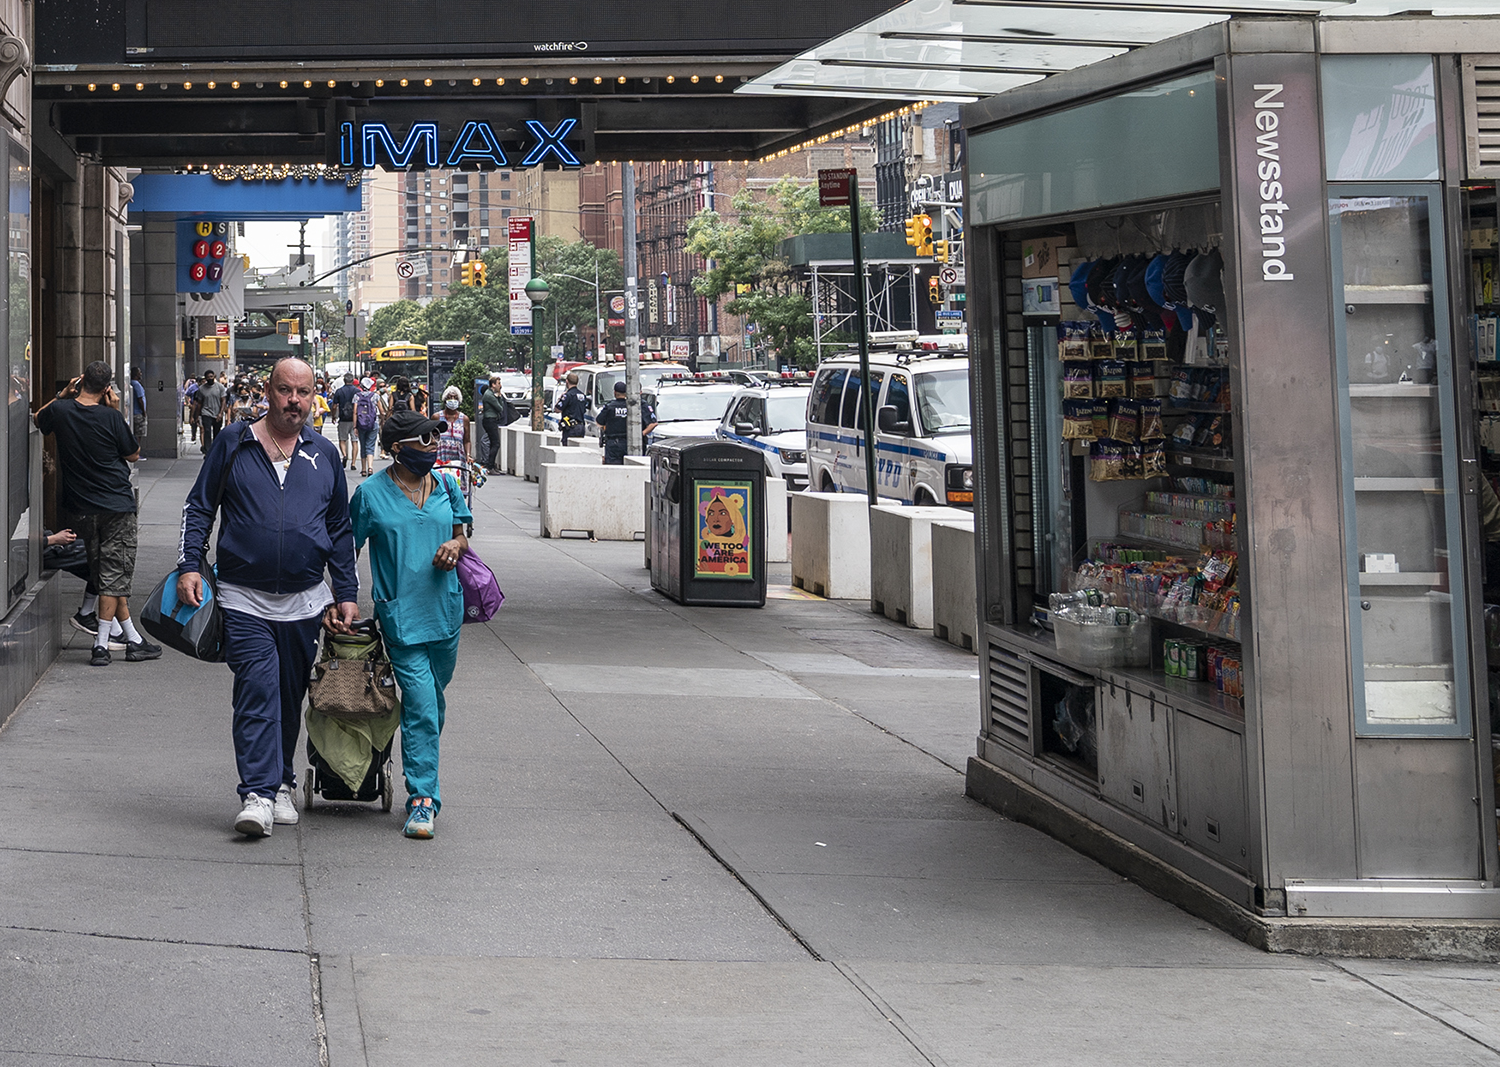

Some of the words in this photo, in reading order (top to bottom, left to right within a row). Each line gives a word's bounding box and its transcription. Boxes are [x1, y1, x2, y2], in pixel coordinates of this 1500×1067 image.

[533, 41, 574, 53] watchfire
[339, 118, 581, 169] IMAX
[820, 181, 841, 190] Anytime
[1252, 83, 1294, 282] Newsstand
[201, 222, 211, 234] R
[217, 222, 226, 234] S
[215, 244, 223, 256] 2
[196, 267, 204, 278] 3
[924, 450, 938, 461] POLICE
[875, 458, 902, 489] YPD
[704, 542, 721, 550] WE
[721, 542, 744, 550] TOO
[701, 556, 747, 564] AMERICA
